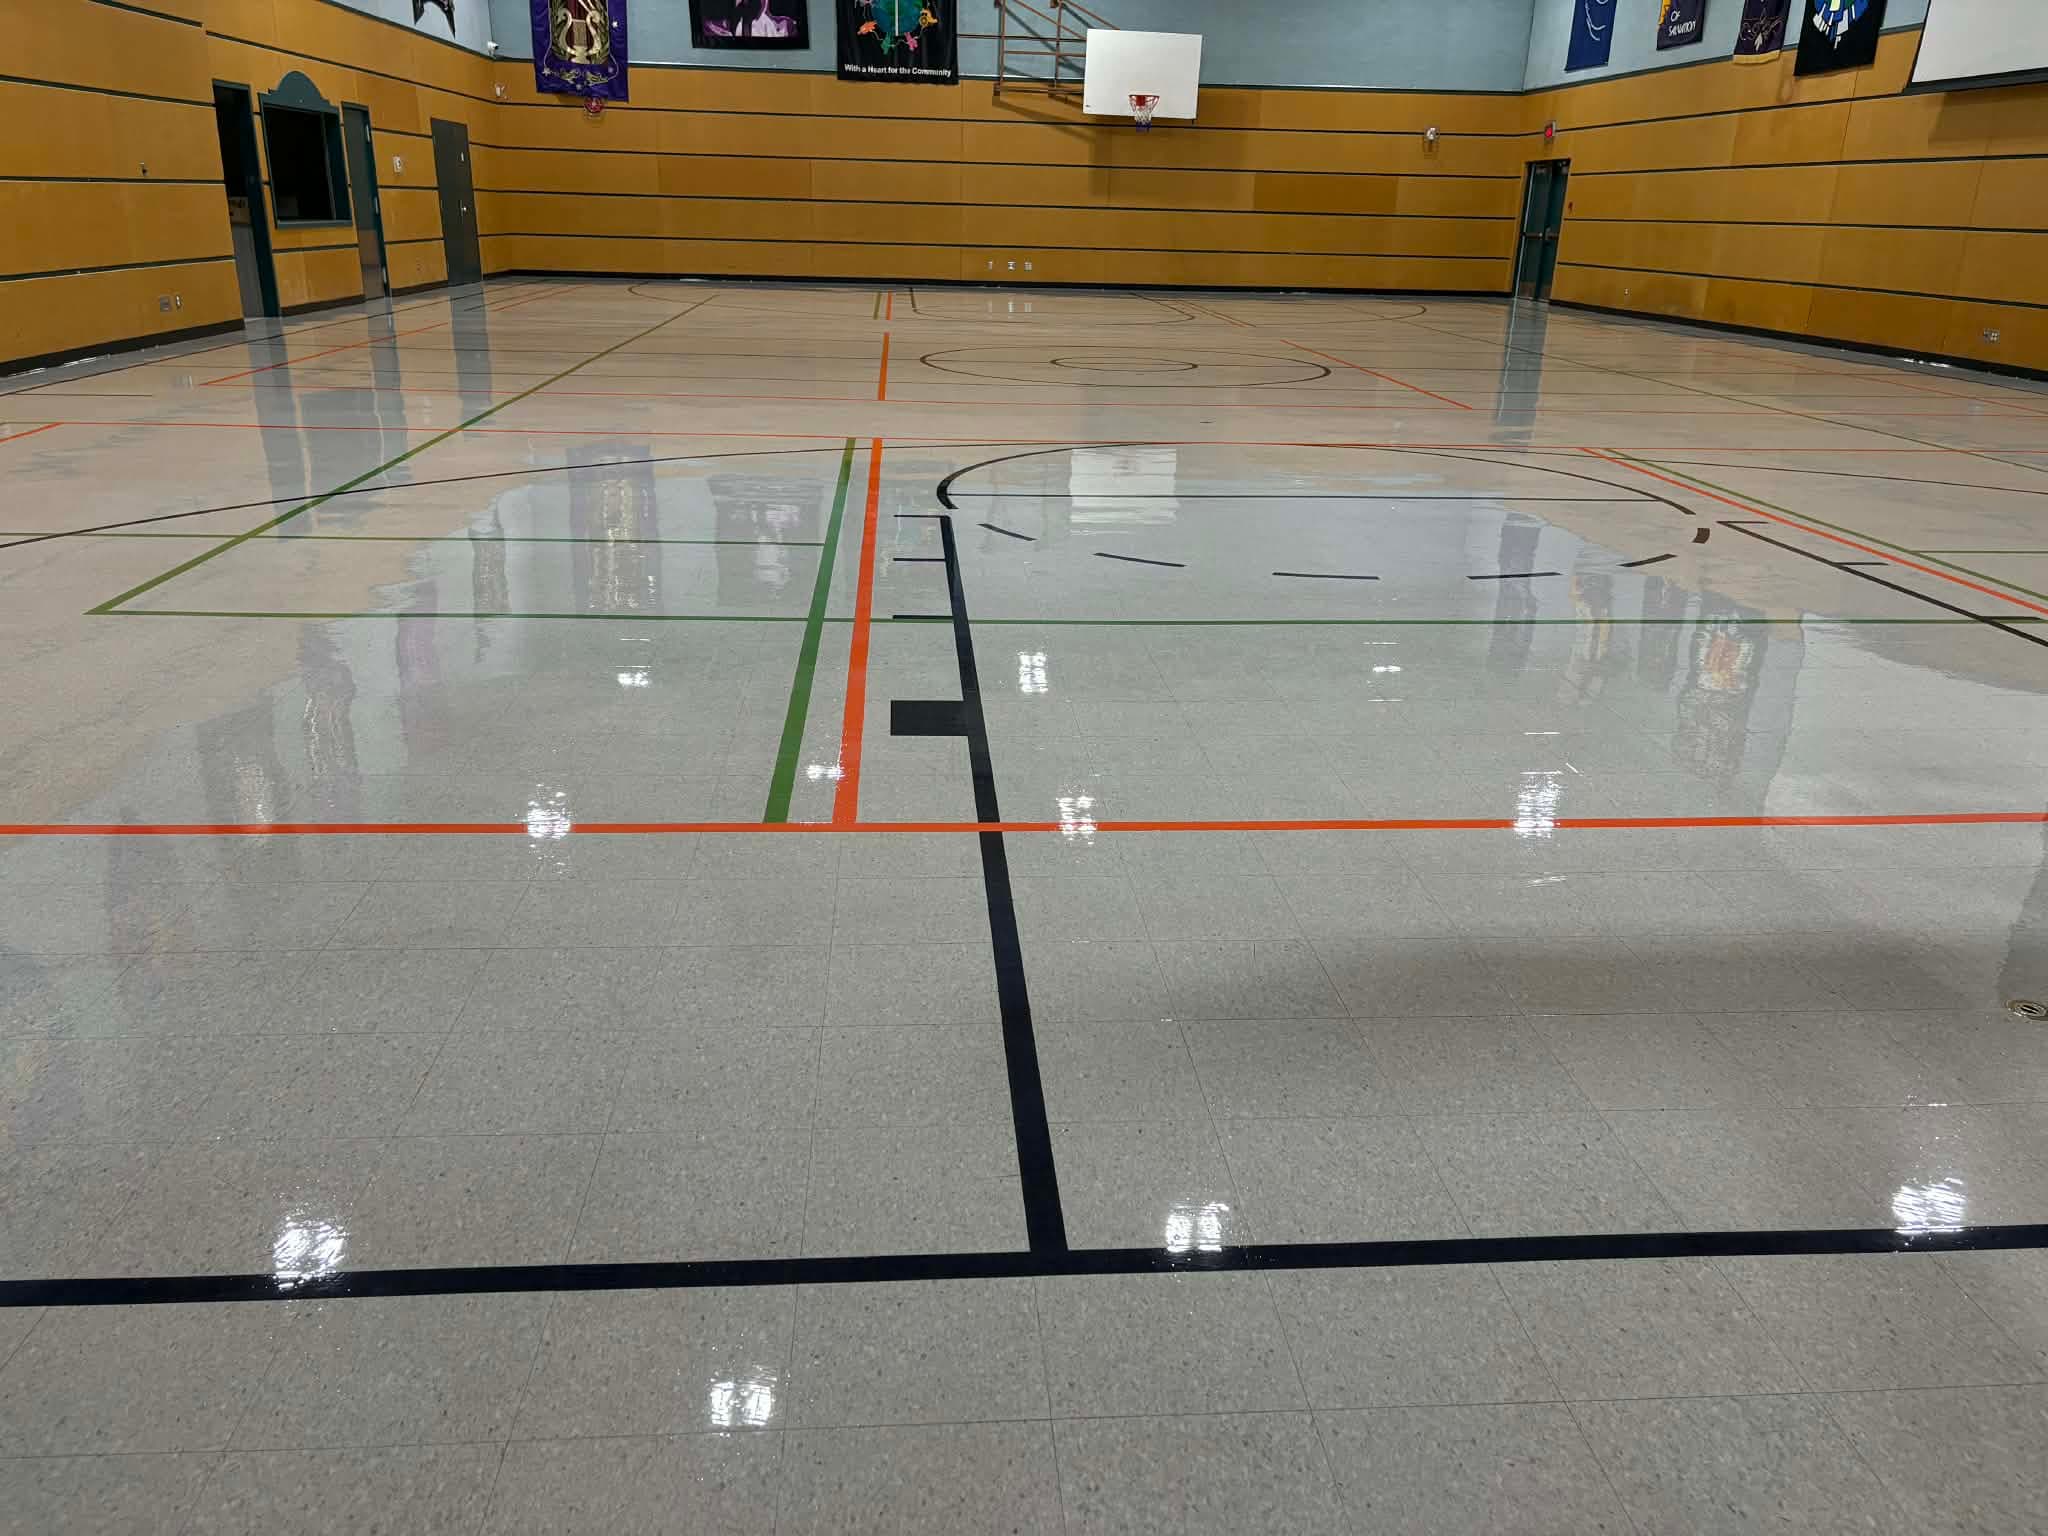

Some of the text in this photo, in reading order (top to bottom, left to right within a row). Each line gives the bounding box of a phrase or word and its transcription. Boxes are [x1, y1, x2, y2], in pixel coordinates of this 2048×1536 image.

[1671, 10, 1680, 22] OF
[844, 64, 861, 72] With
[868, 65, 887, 74] Heart
[888, 66, 898, 74] for
[912, 67, 951, 77] Community
